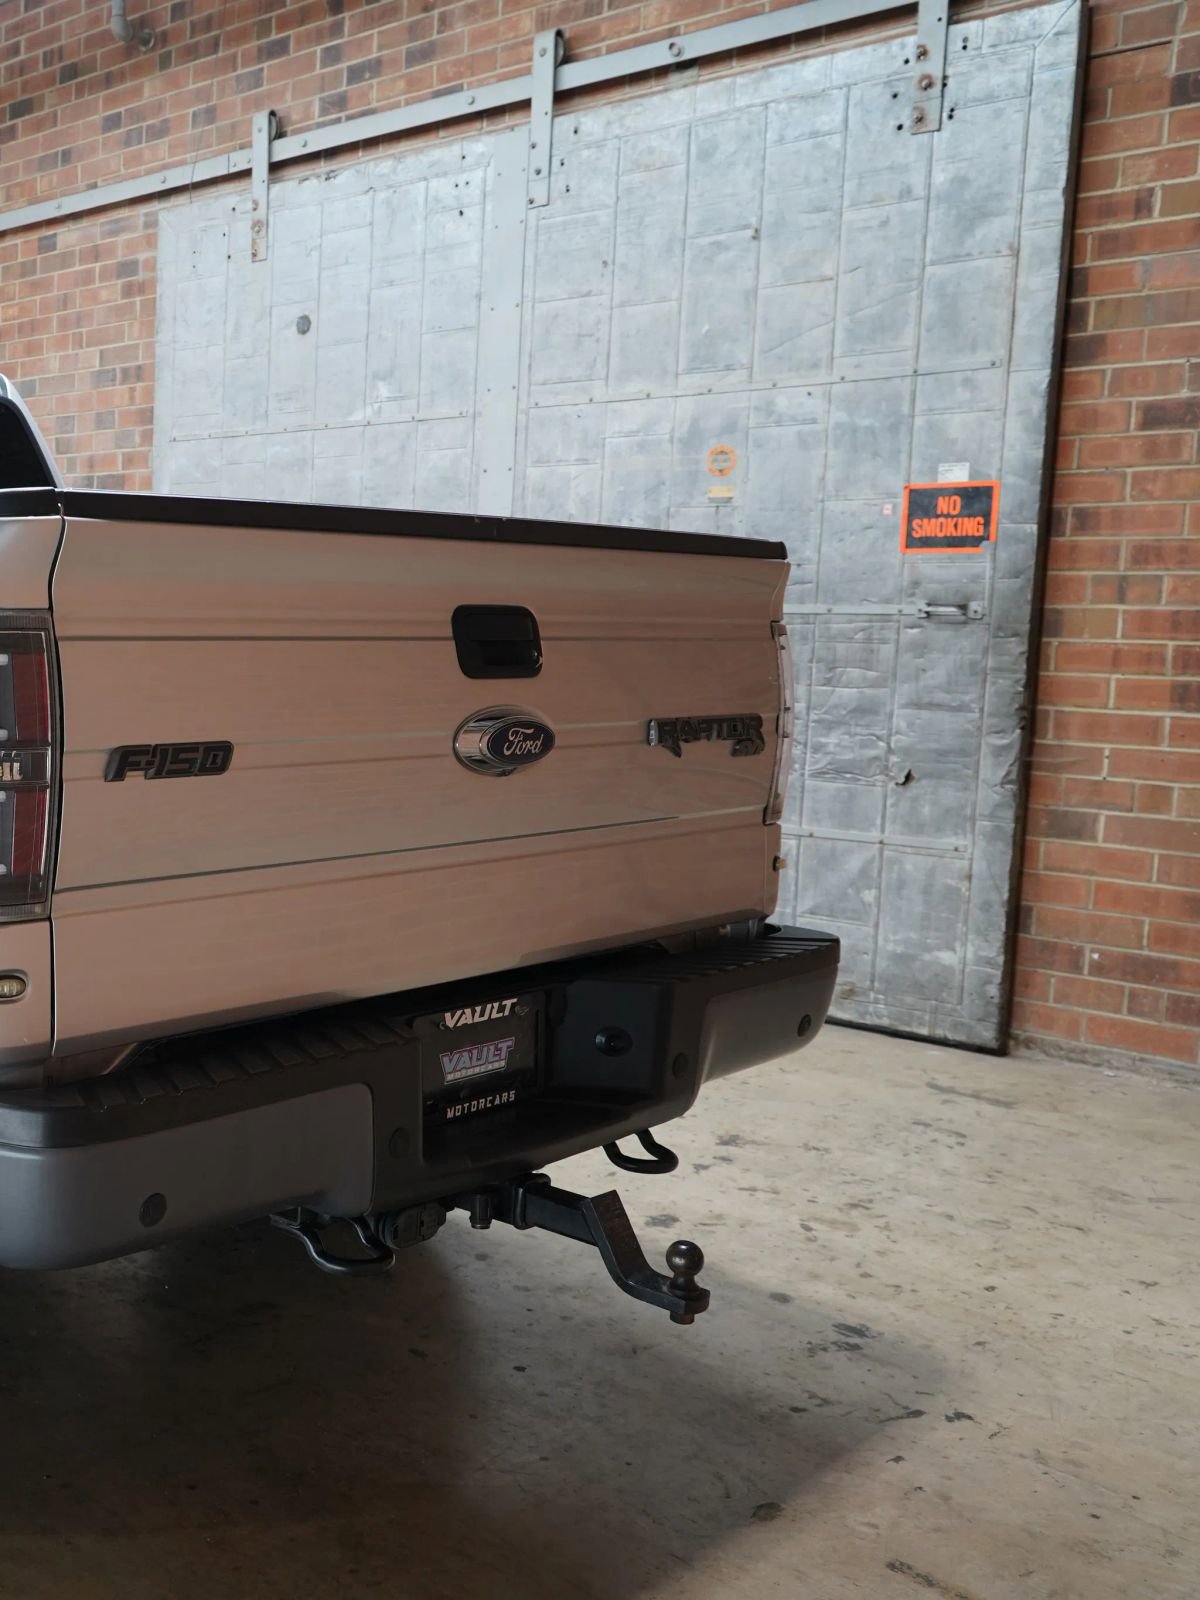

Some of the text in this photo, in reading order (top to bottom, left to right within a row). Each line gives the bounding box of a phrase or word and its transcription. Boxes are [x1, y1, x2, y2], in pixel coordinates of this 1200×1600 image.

[936, 495, 961, 515] NO
[911, 516, 984, 538] SMOKING
[503, 727, 544, 756] Ford
[649, 714, 765, 757] RAPTOR
[104, 740, 234, 782] F-150
[444, 998, 518, 1030] VAULT
[441, 1040, 513, 1073] VAULT
[446, 1090, 516, 1119] MOTORCARS
